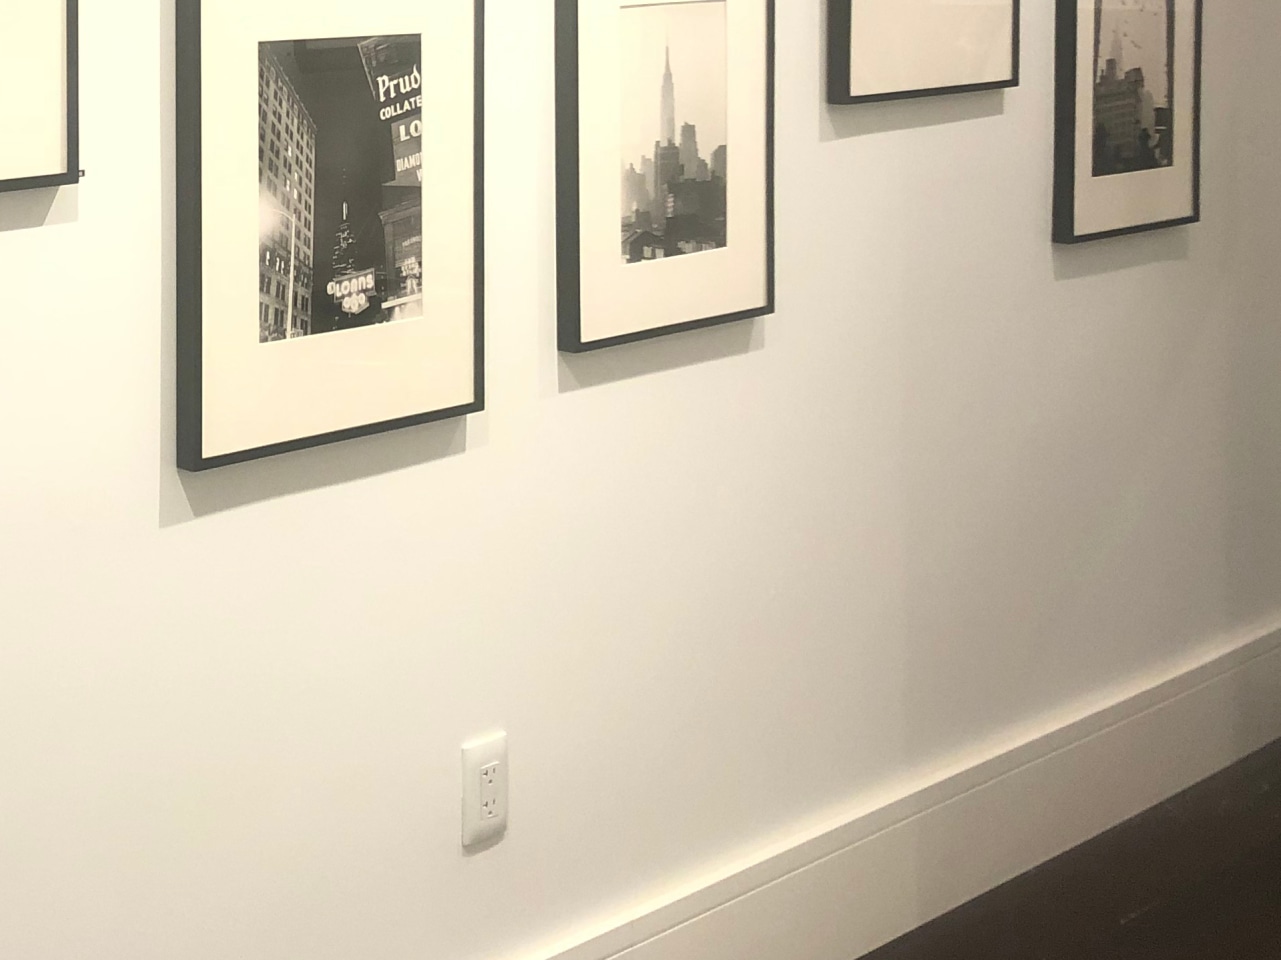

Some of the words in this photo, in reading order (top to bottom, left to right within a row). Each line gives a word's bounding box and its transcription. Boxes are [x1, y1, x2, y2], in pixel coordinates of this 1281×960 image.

[376, 64, 421, 102] Prud
[380, 95, 422, 120] COLLATE
[399, 120, 422, 141] LO
[396, 152, 422, 172] DIAMO
